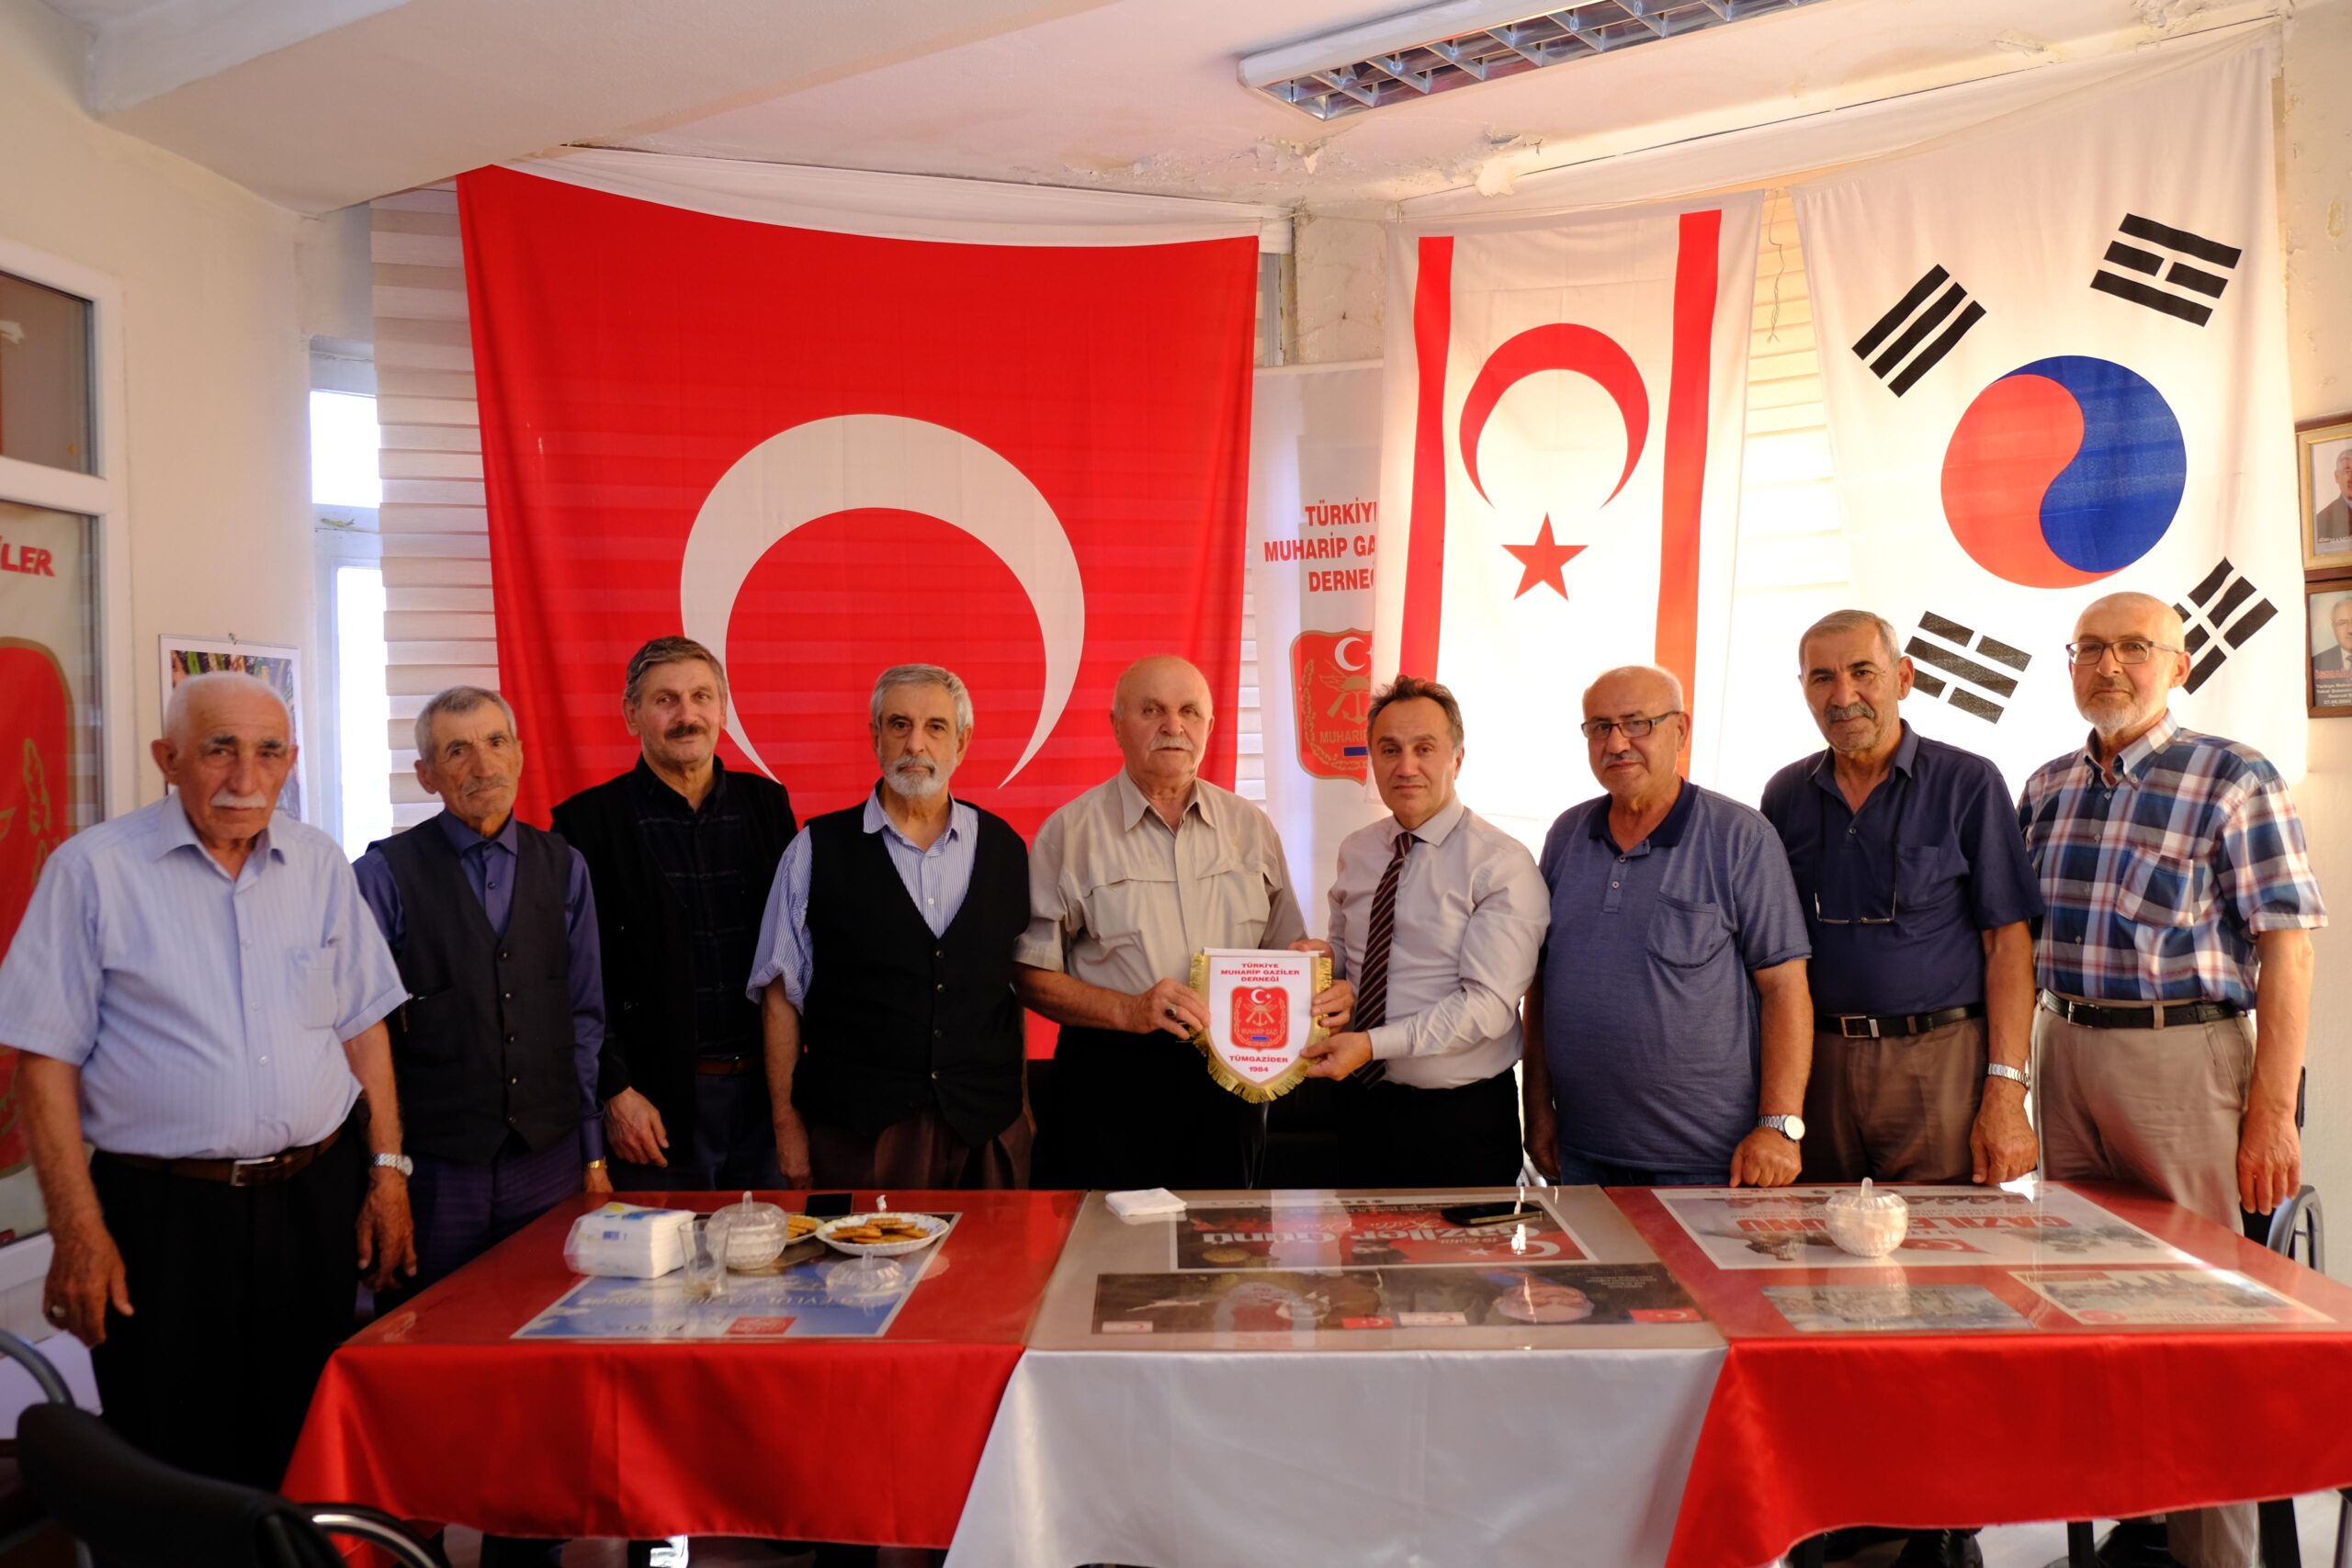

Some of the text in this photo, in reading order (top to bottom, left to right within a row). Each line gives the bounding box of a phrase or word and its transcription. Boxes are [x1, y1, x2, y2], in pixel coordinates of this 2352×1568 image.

[0, 536, 55, 577] LER
[1264, 532, 1348, 562] MUHARİP
[1308, 563, 1374, 592] DERNE
[1228, 1055, 1288, 1064] TÜMGAZİDER
